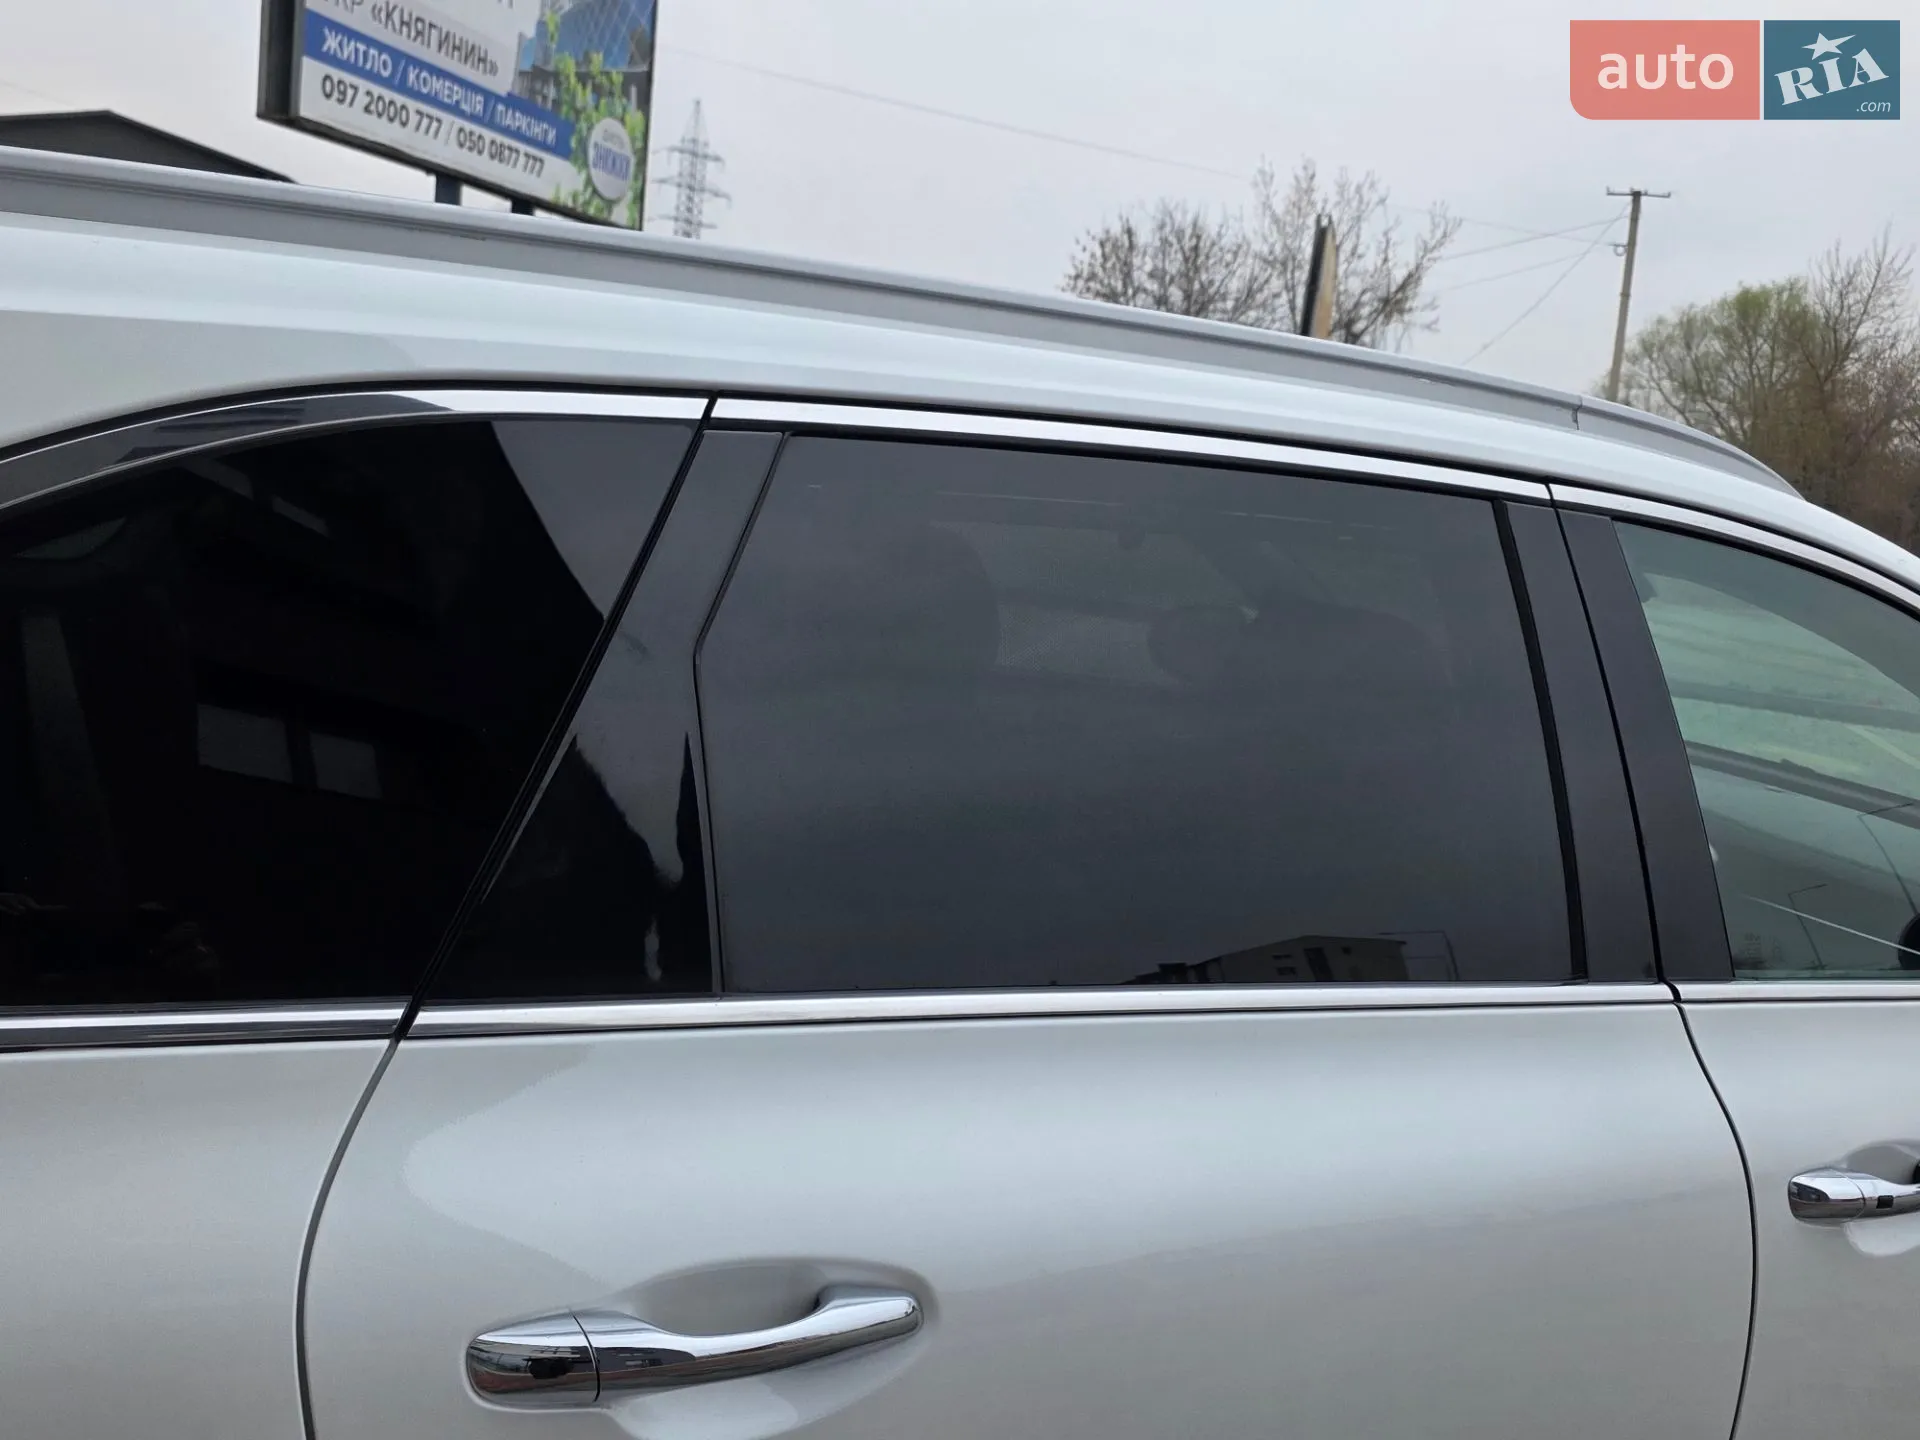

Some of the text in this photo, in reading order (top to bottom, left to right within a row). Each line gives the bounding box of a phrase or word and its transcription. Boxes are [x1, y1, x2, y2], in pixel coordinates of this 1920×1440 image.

[321, 26, 393, 77] ЖИТЛО
[406, 65, 485, 117] КОМЕРЦІЯ
[495, 102, 556, 148] ПАРКІНГИ
[371, 0, 499, 76] «КНЯГИНИН»
[321, 74, 359, 108] 097
[363, 91, 410, 128] 2000
[414, 110, 443, 140] 777
[457, 127, 486, 156] 050
[489, 139, 520, 169] 0877
[522, 150, 545, 178] 777
